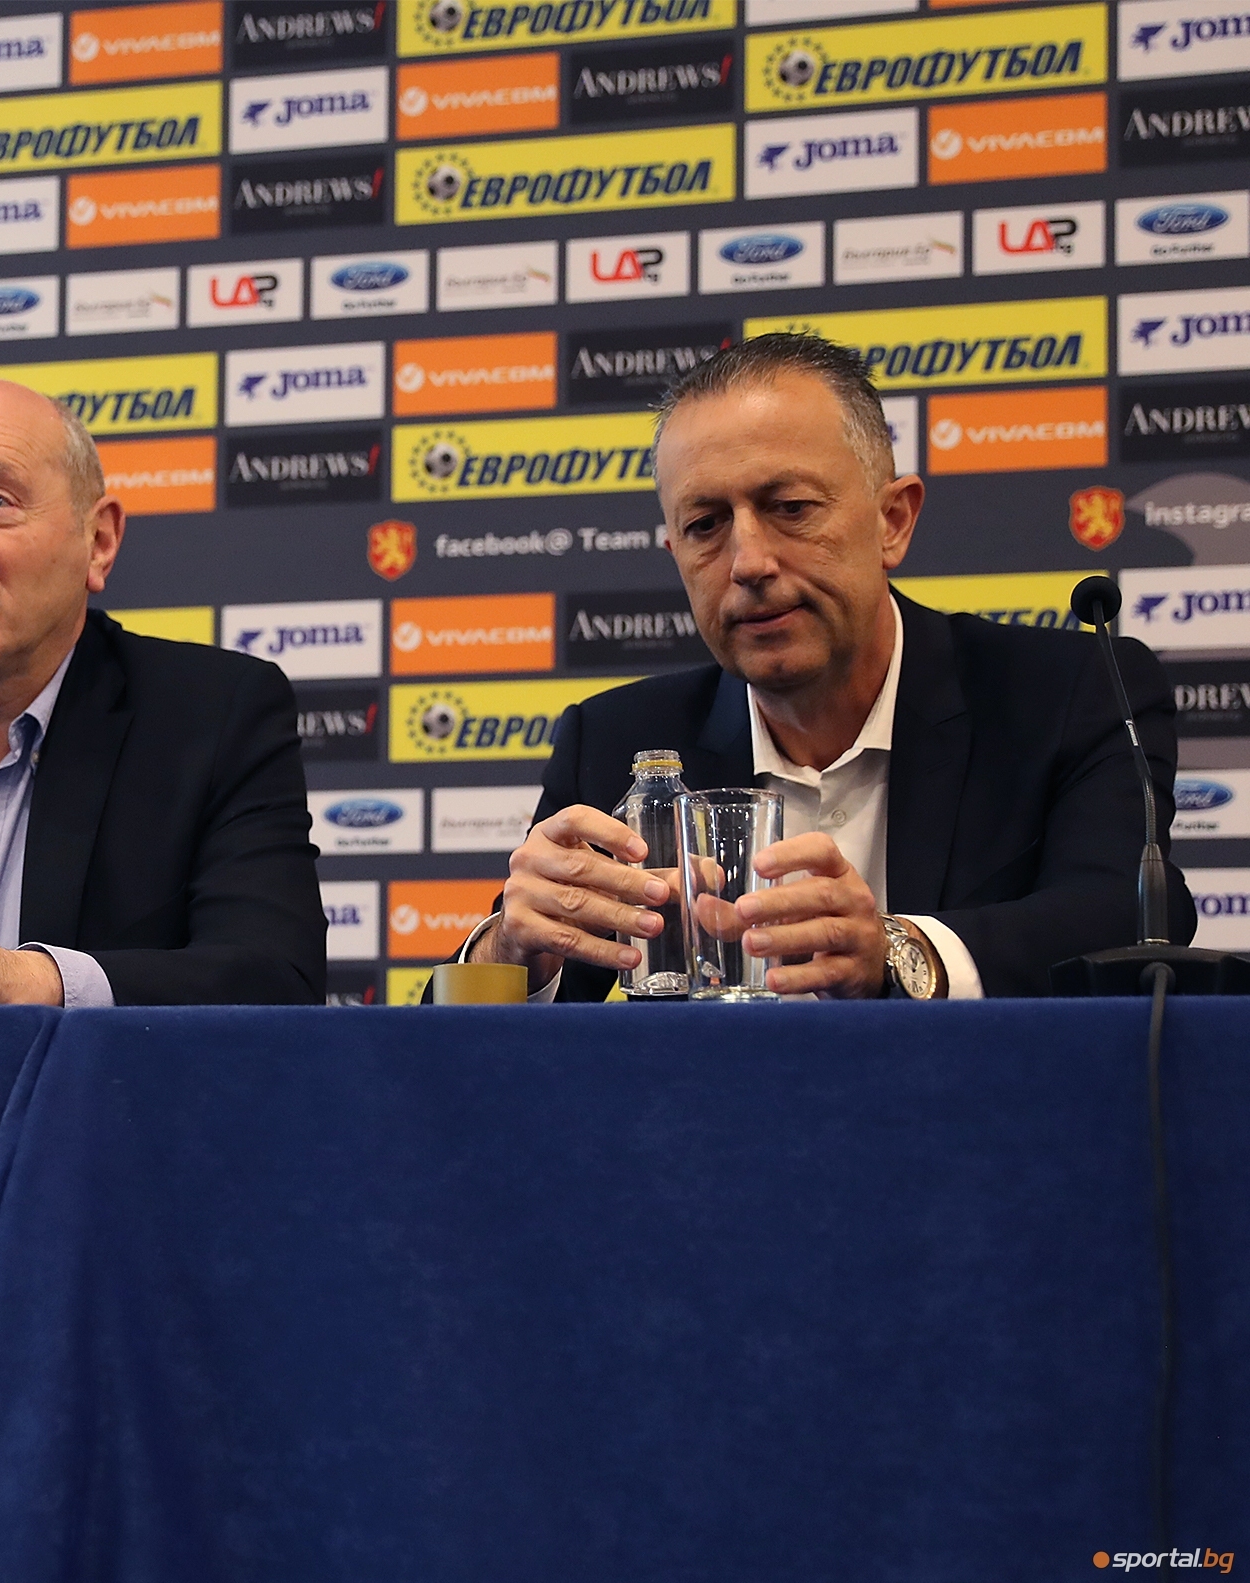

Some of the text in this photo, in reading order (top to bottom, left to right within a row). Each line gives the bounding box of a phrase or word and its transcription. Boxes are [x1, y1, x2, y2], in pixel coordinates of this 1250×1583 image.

[103, 30, 221, 56] VIVACOM
[813, 41, 1085, 96] ЕВРОФУТБОЛ
[432, 85, 557, 110] VIVACOM
[968, 126, 1105, 152] VIVACOM
[459, 160, 713, 210] ЕВРОФУТБОЛ
[101, 194, 218, 219] VIVACOM
[429, 365, 555, 388] VIVACOM
[966, 419, 1105, 443] VIVACOM
[265, 624, 365, 656] Joma
[424, 627, 552, 647] VIVACOM
